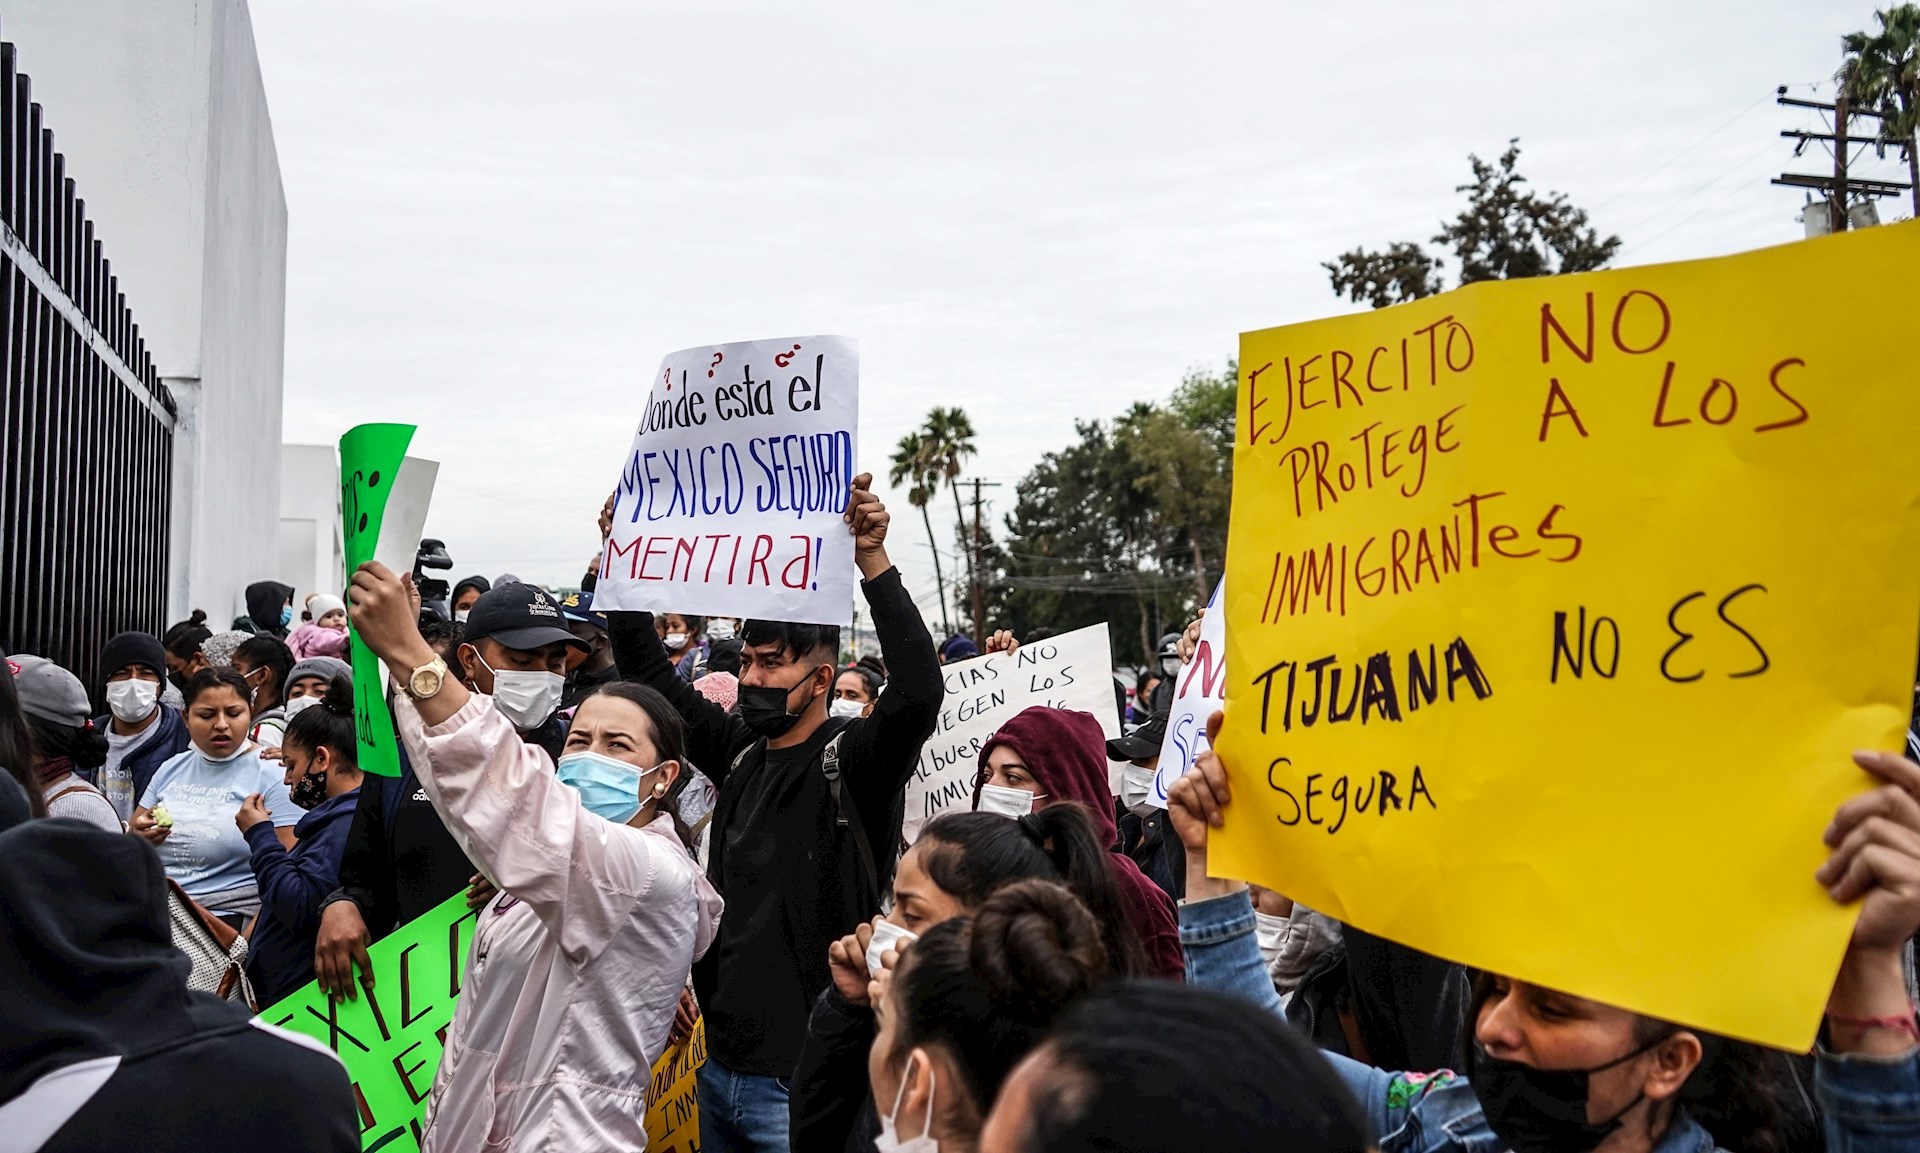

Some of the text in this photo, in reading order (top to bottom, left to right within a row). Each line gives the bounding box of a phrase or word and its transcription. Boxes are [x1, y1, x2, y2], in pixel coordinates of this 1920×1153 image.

[715, 364, 774, 421] esta
[788, 354, 823, 412] el
[1247, 291, 1671, 446] EJERCITO NO
[1539, 378, 1588, 441] A
[613, 431, 851, 523] MEXICO SEGURO
[1018, 645, 1057, 668] NO
[1179, 640, 1225, 701] N
[1252, 584, 1770, 734] TIJUANA NO ES
[273, 909, 479, 1054] XICO
